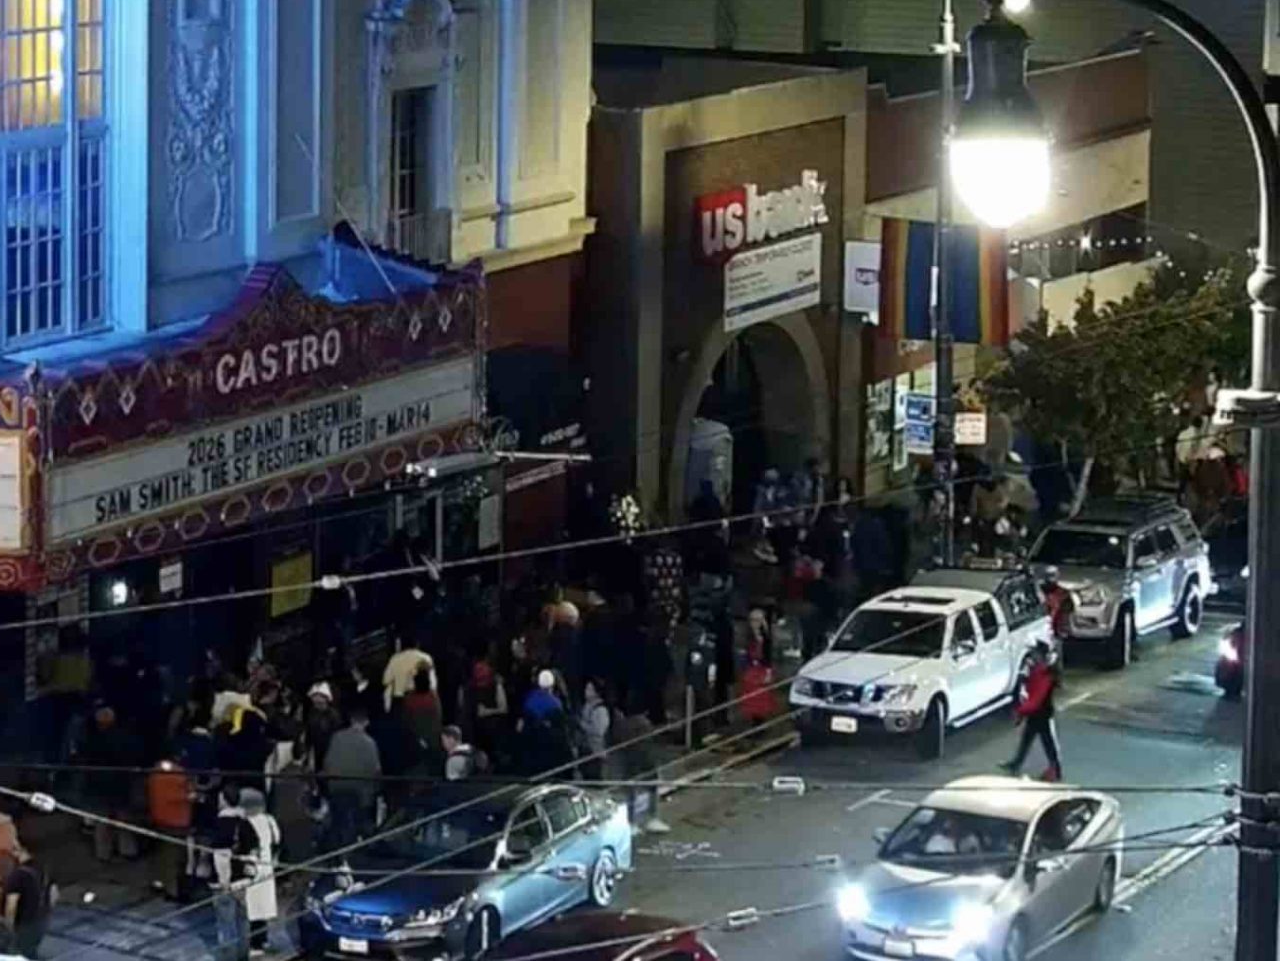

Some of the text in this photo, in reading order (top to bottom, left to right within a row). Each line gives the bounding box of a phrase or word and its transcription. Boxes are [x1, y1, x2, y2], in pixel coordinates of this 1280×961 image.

[216, 328, 341, 394] CASTRO
[94, 489, 132, 523] SAM
[202, 462, 229, 493] THE
[233, 455, 253, 482] SF
